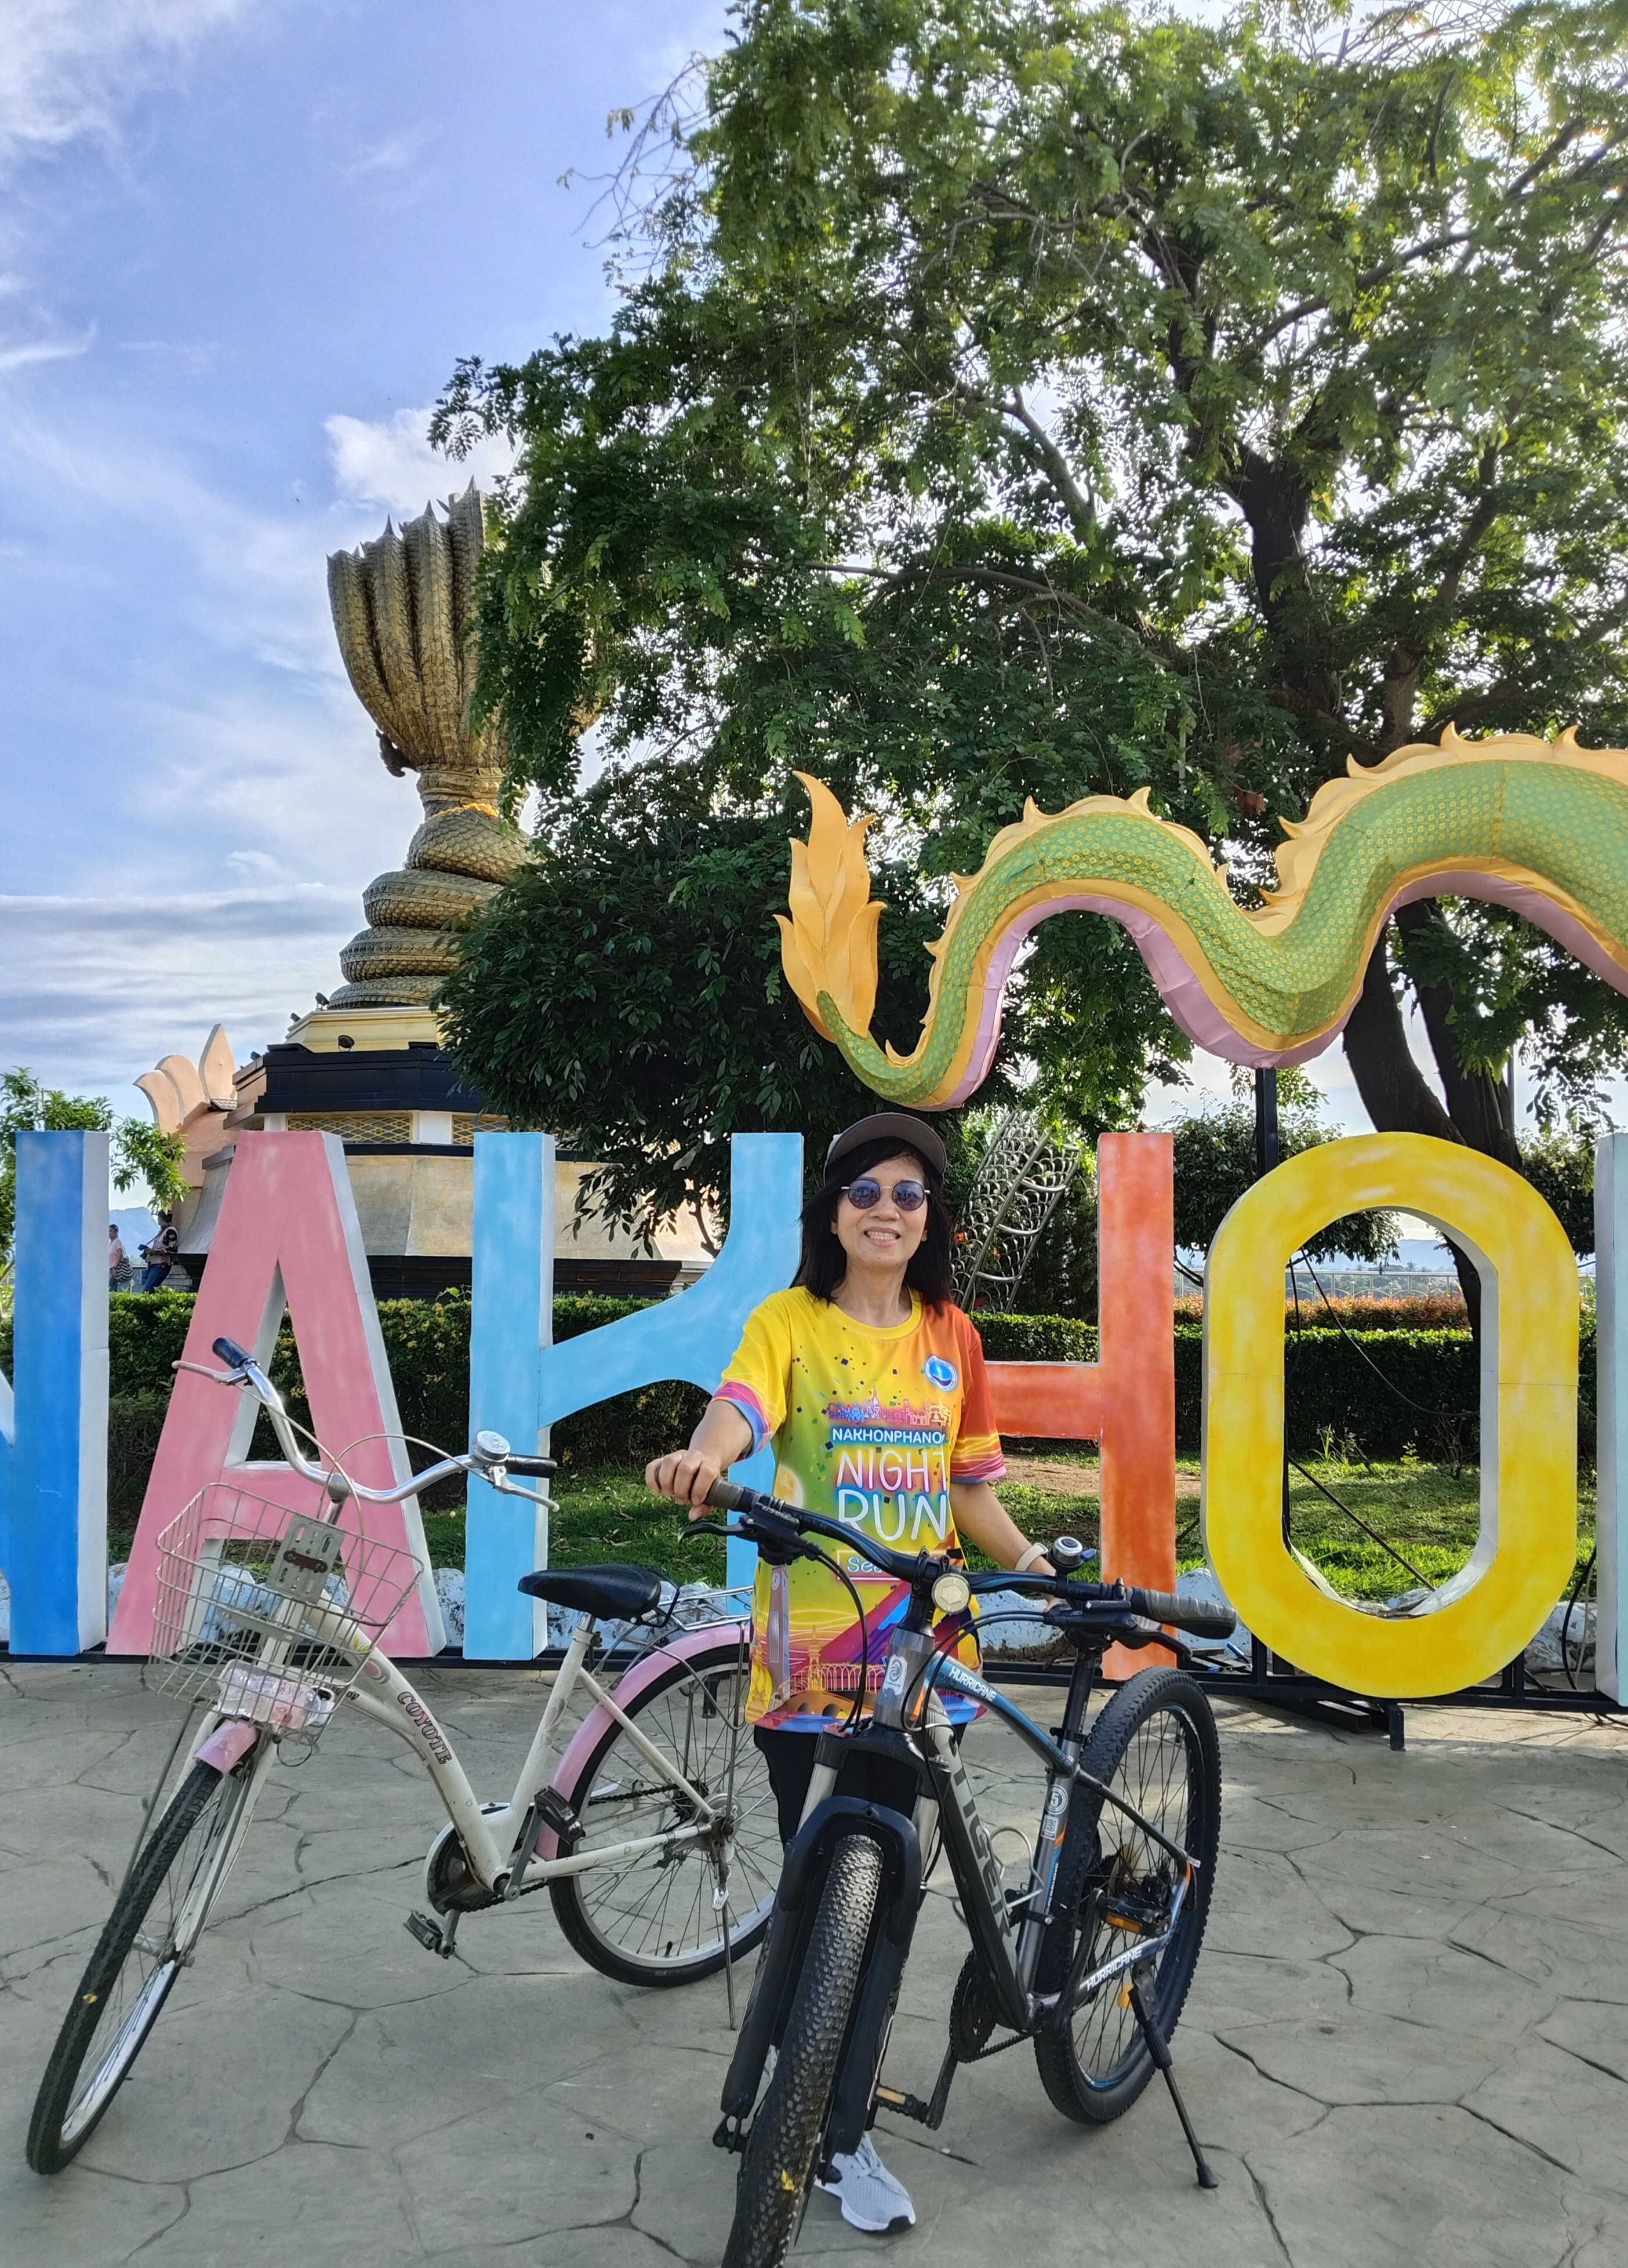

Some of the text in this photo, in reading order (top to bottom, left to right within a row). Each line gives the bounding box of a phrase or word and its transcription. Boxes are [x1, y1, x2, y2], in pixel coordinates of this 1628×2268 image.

[837, 1449, 947, 1493] NIGHT
[838, 1489, 947, 1542] RUN
[847, 1556, 882, 1573] Sea
[949, 1666, 997, 1702] HURRICANE
[397, 1691, 453, 1765] COYOTE
[1086, 1946, 1143, 1991] HURRICANE
